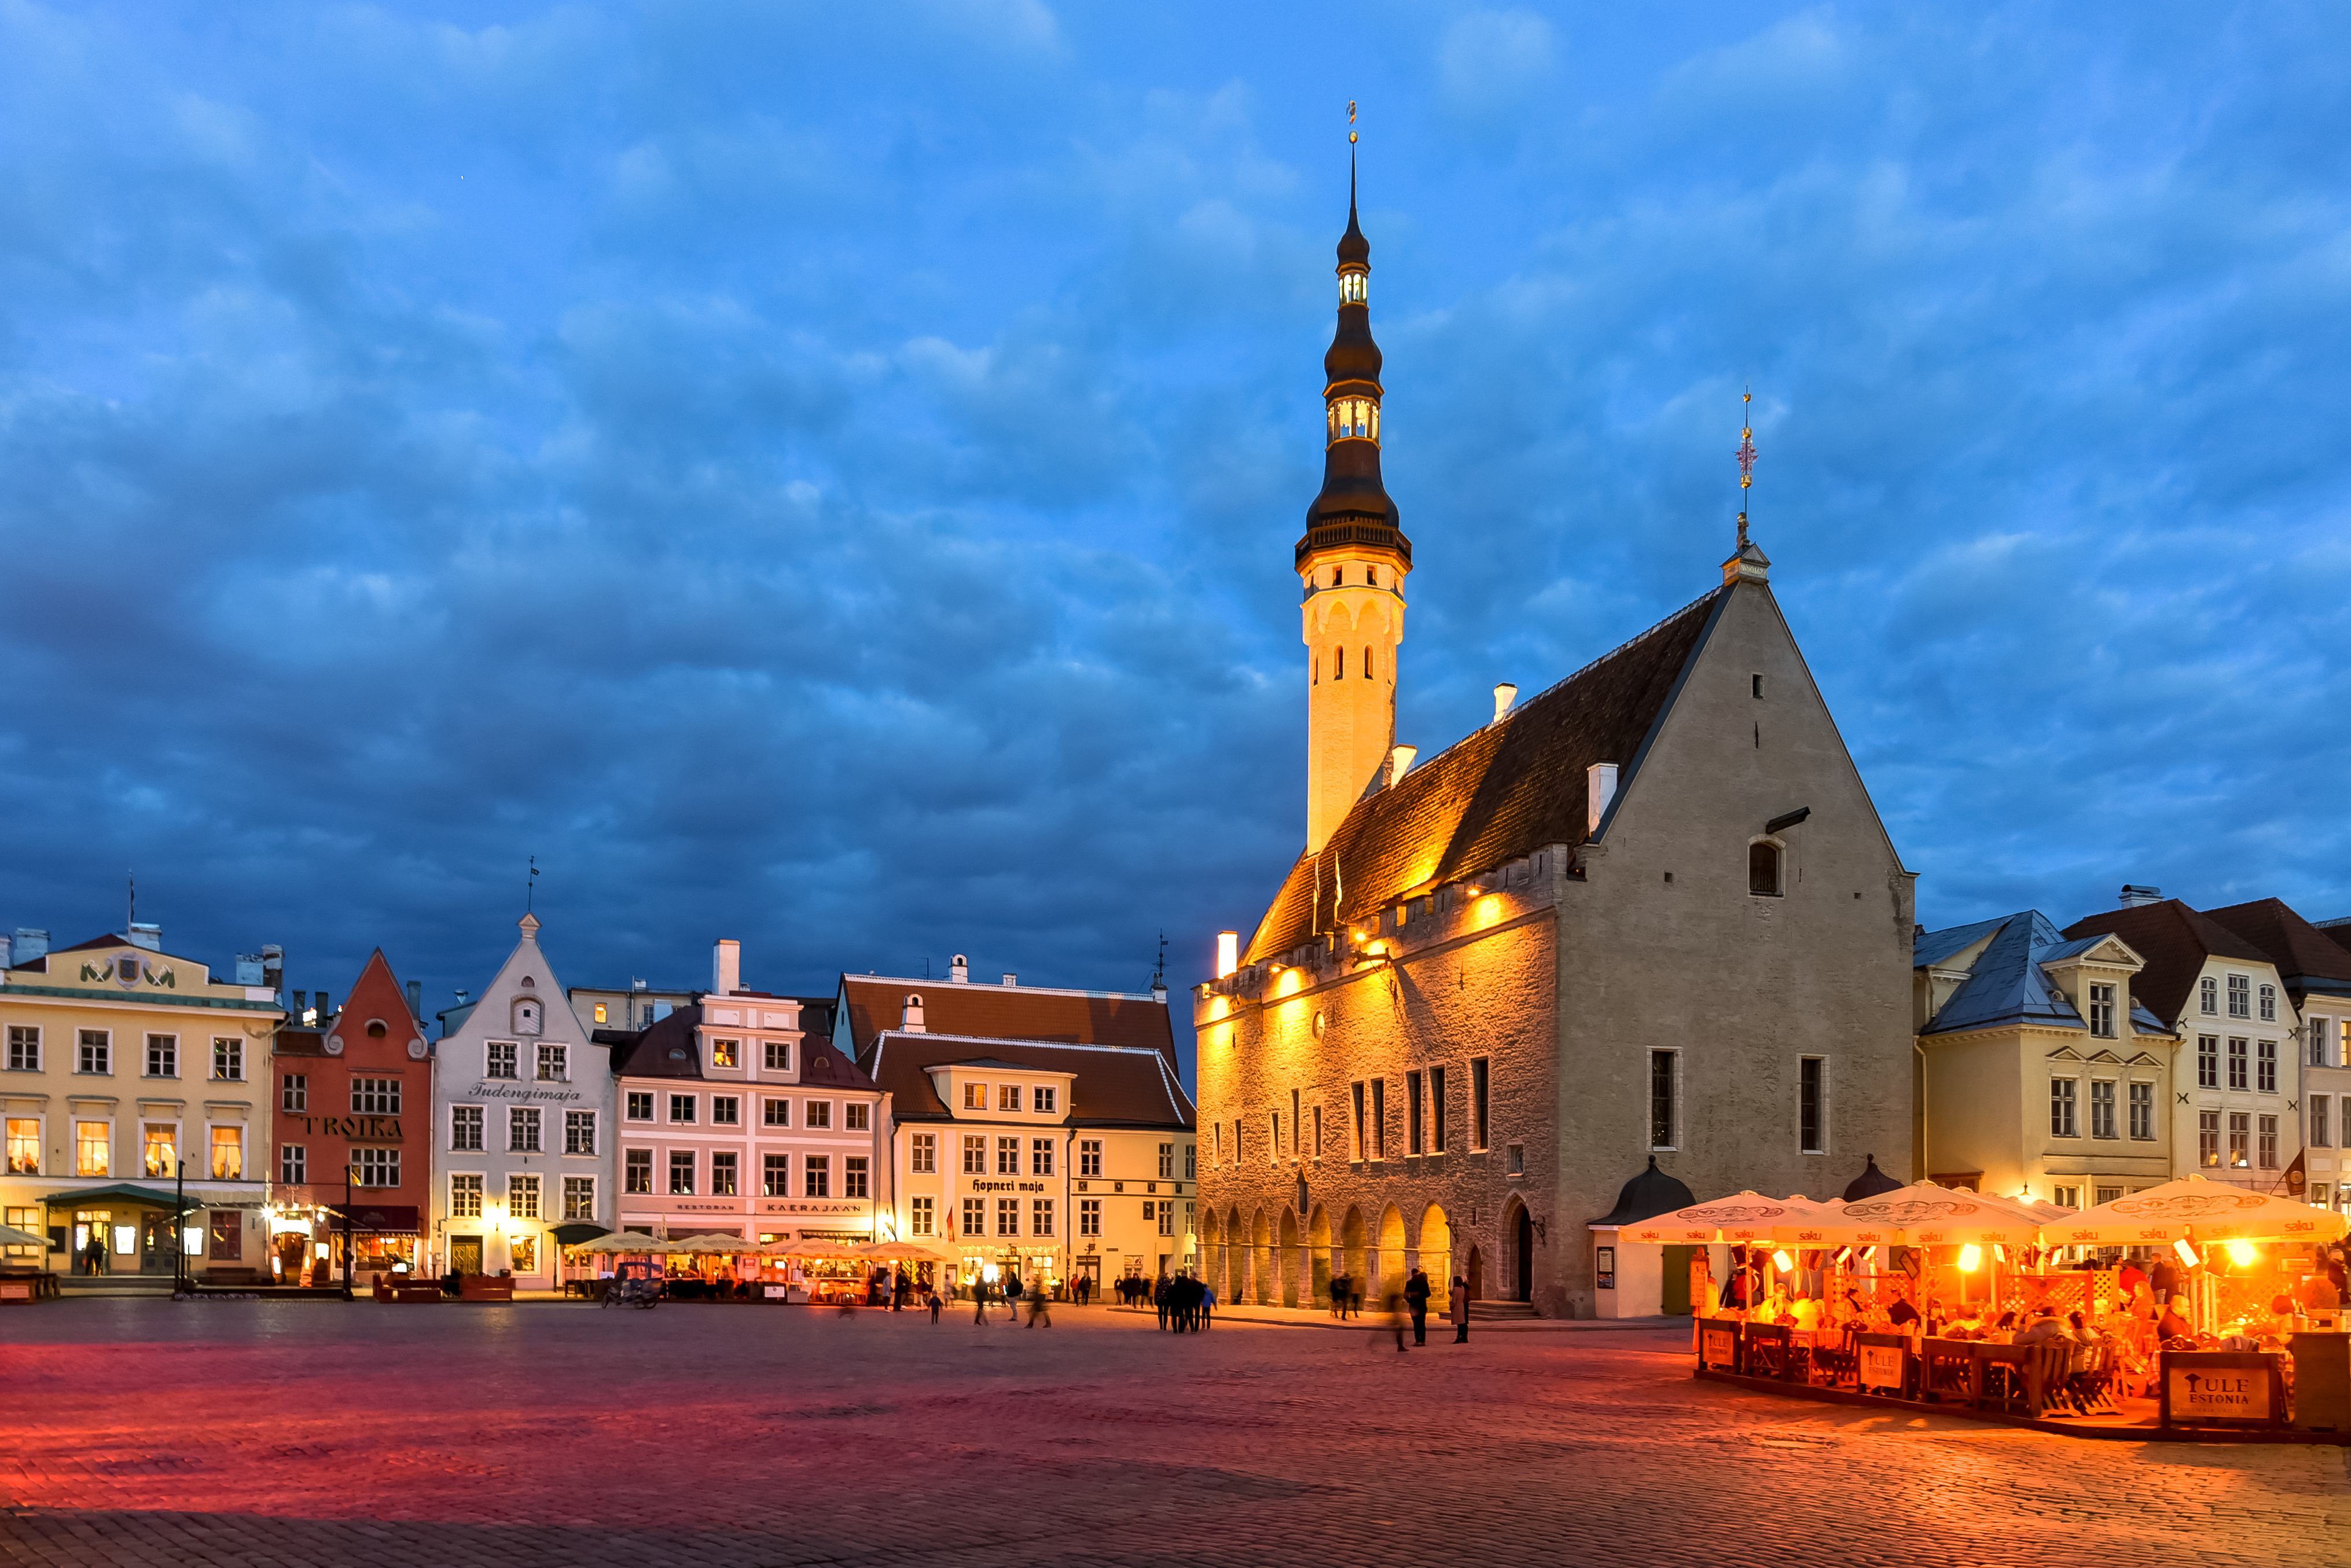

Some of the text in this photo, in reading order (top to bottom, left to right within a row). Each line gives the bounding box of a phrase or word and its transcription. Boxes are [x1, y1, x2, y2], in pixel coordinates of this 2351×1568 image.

[468, 1082, 582, 1106] Tudengimaja
[300, 1117, 403, 1137] TROIKA
[1019, 1181, 1044, 1194] maja
[767, 1203, 861, 1213] KAERAJAAN
[2284, 1220, 2315, 1232] saku
[1641, 1231, 1659, 1239] saku
[1687, 1231, 1705, 1239] saku
[1735, 1229, 1754, 1239] saku
[1799, 1231, 1821, 1241] saku
[1857, 1231, 1880, 1242] saku
[1919, 1232, 1942, 1242] saku
[1981, 1231, 2005, 1242] saku
[2072, 1229, 2099, 1240] saku
[2140, 1228, 2167, 1239] saku
[2189, 1394, 2249, 1404] ESTONIA
